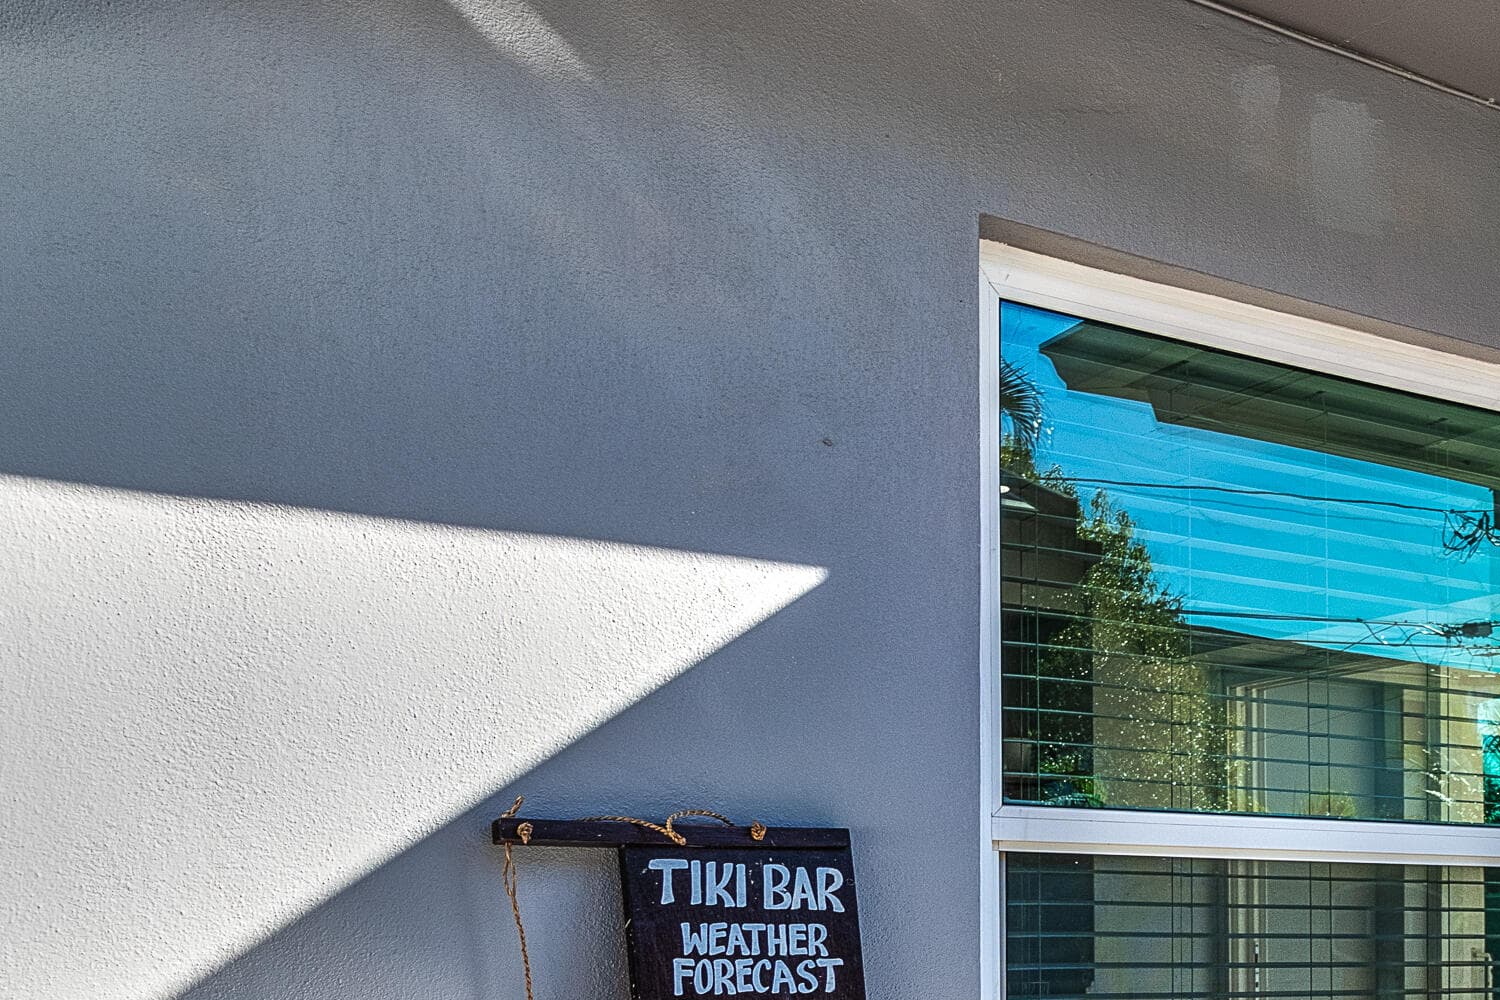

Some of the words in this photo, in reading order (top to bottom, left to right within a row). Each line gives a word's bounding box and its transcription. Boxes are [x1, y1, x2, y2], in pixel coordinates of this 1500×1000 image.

[648, 858, 747, 907] TIKI
[763, 863, 845, 912] BAR
[680, 922, 829, 957] WEATHER
[673, 958, 844, 996] FORECAST
